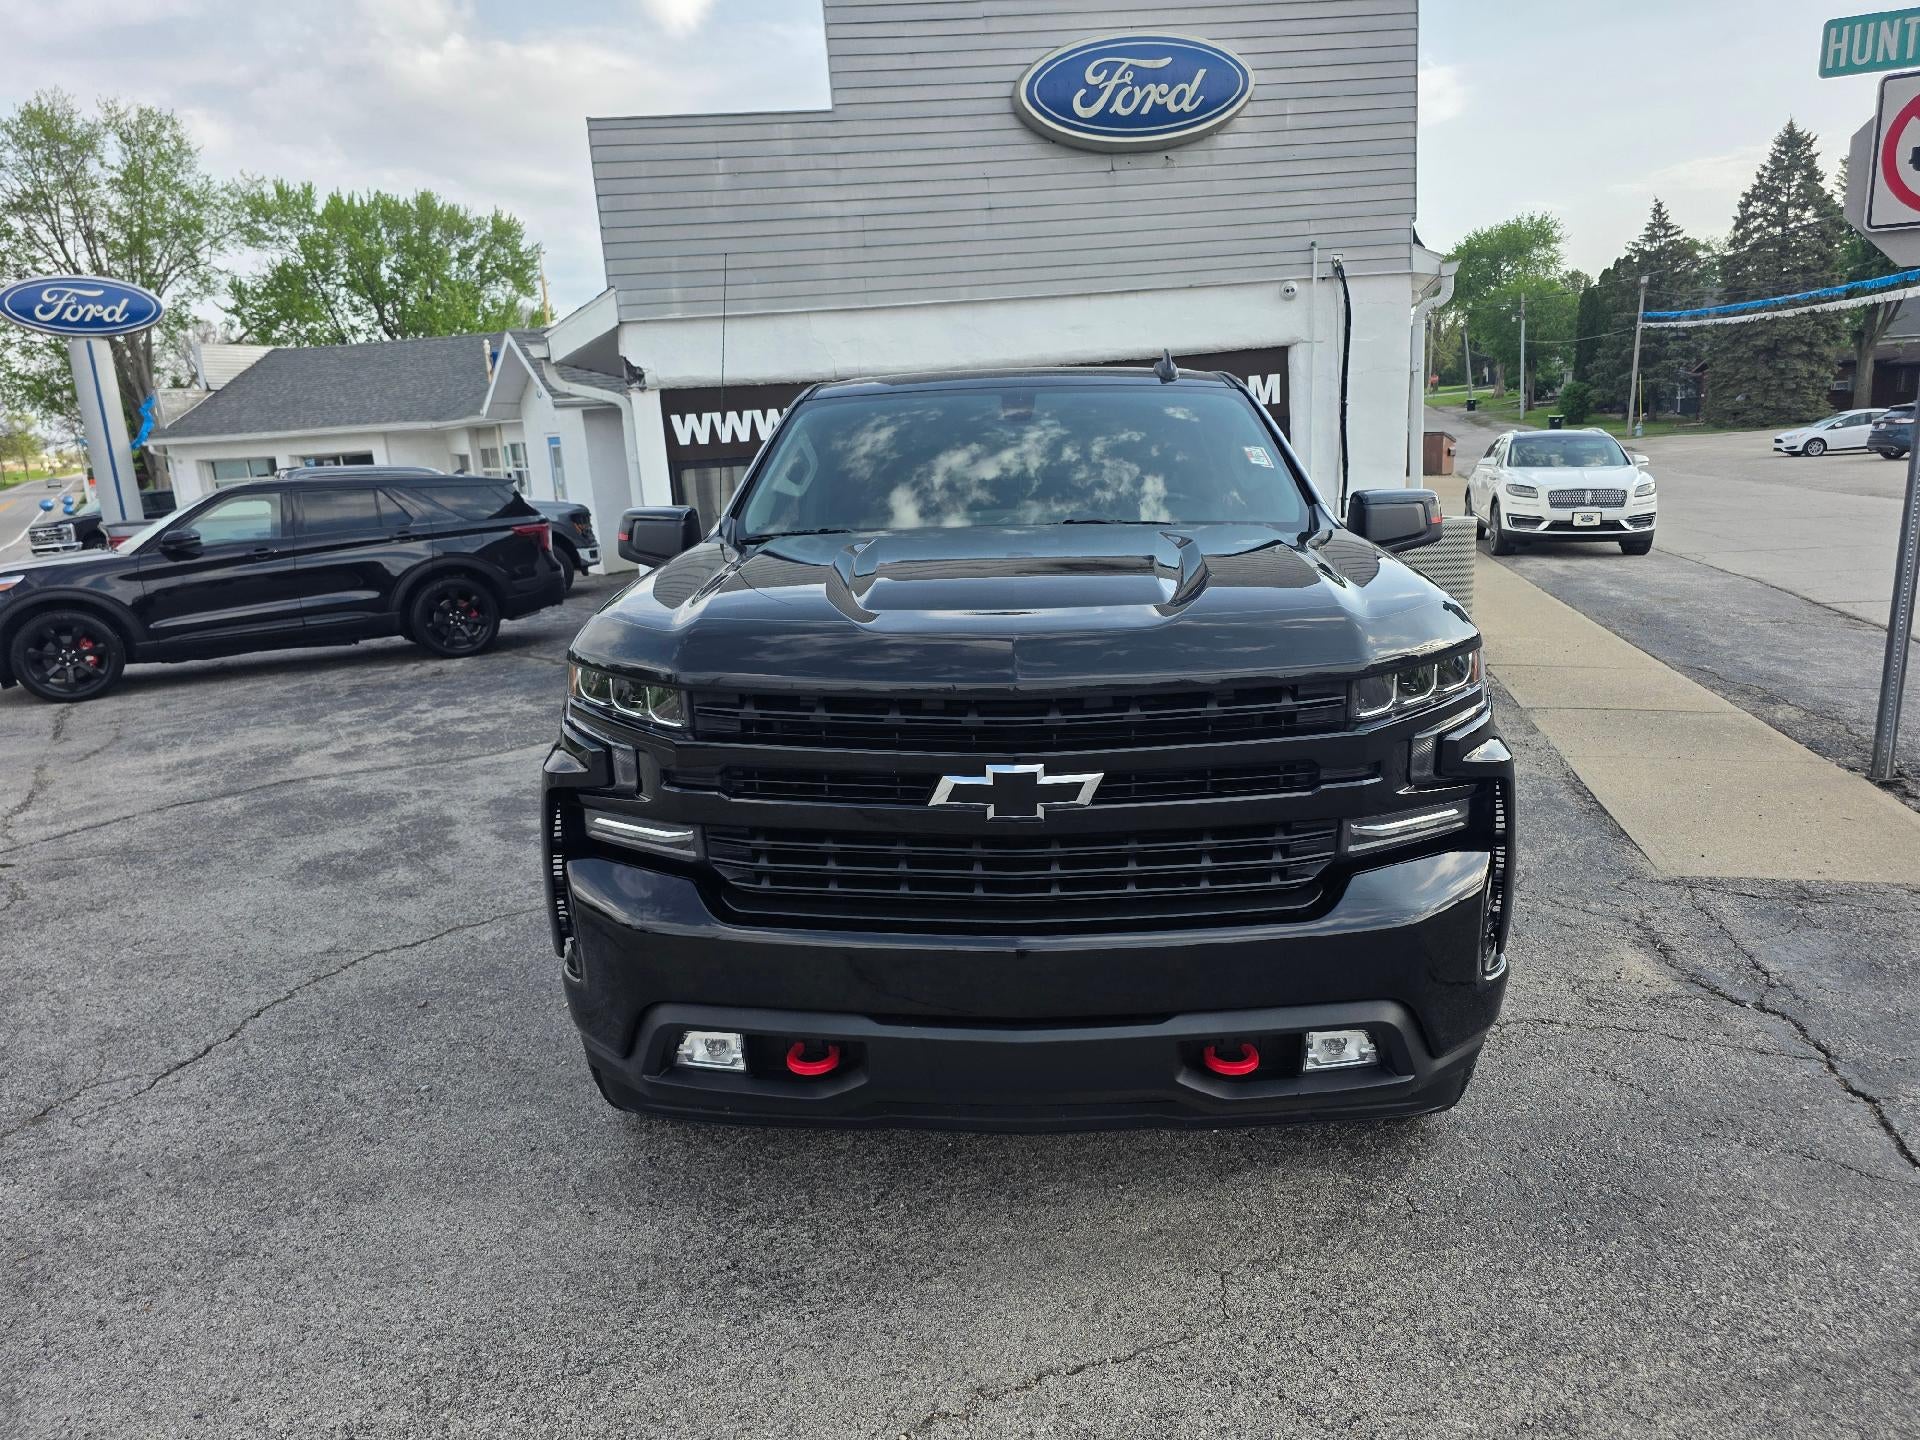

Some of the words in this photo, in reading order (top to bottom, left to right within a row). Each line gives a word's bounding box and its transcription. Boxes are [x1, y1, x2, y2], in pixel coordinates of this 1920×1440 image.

[1825, 16, 1920, 69] HUNT
[1072, 57, 1206, 118] Ford
[34, 287, 129, 323] Ford
